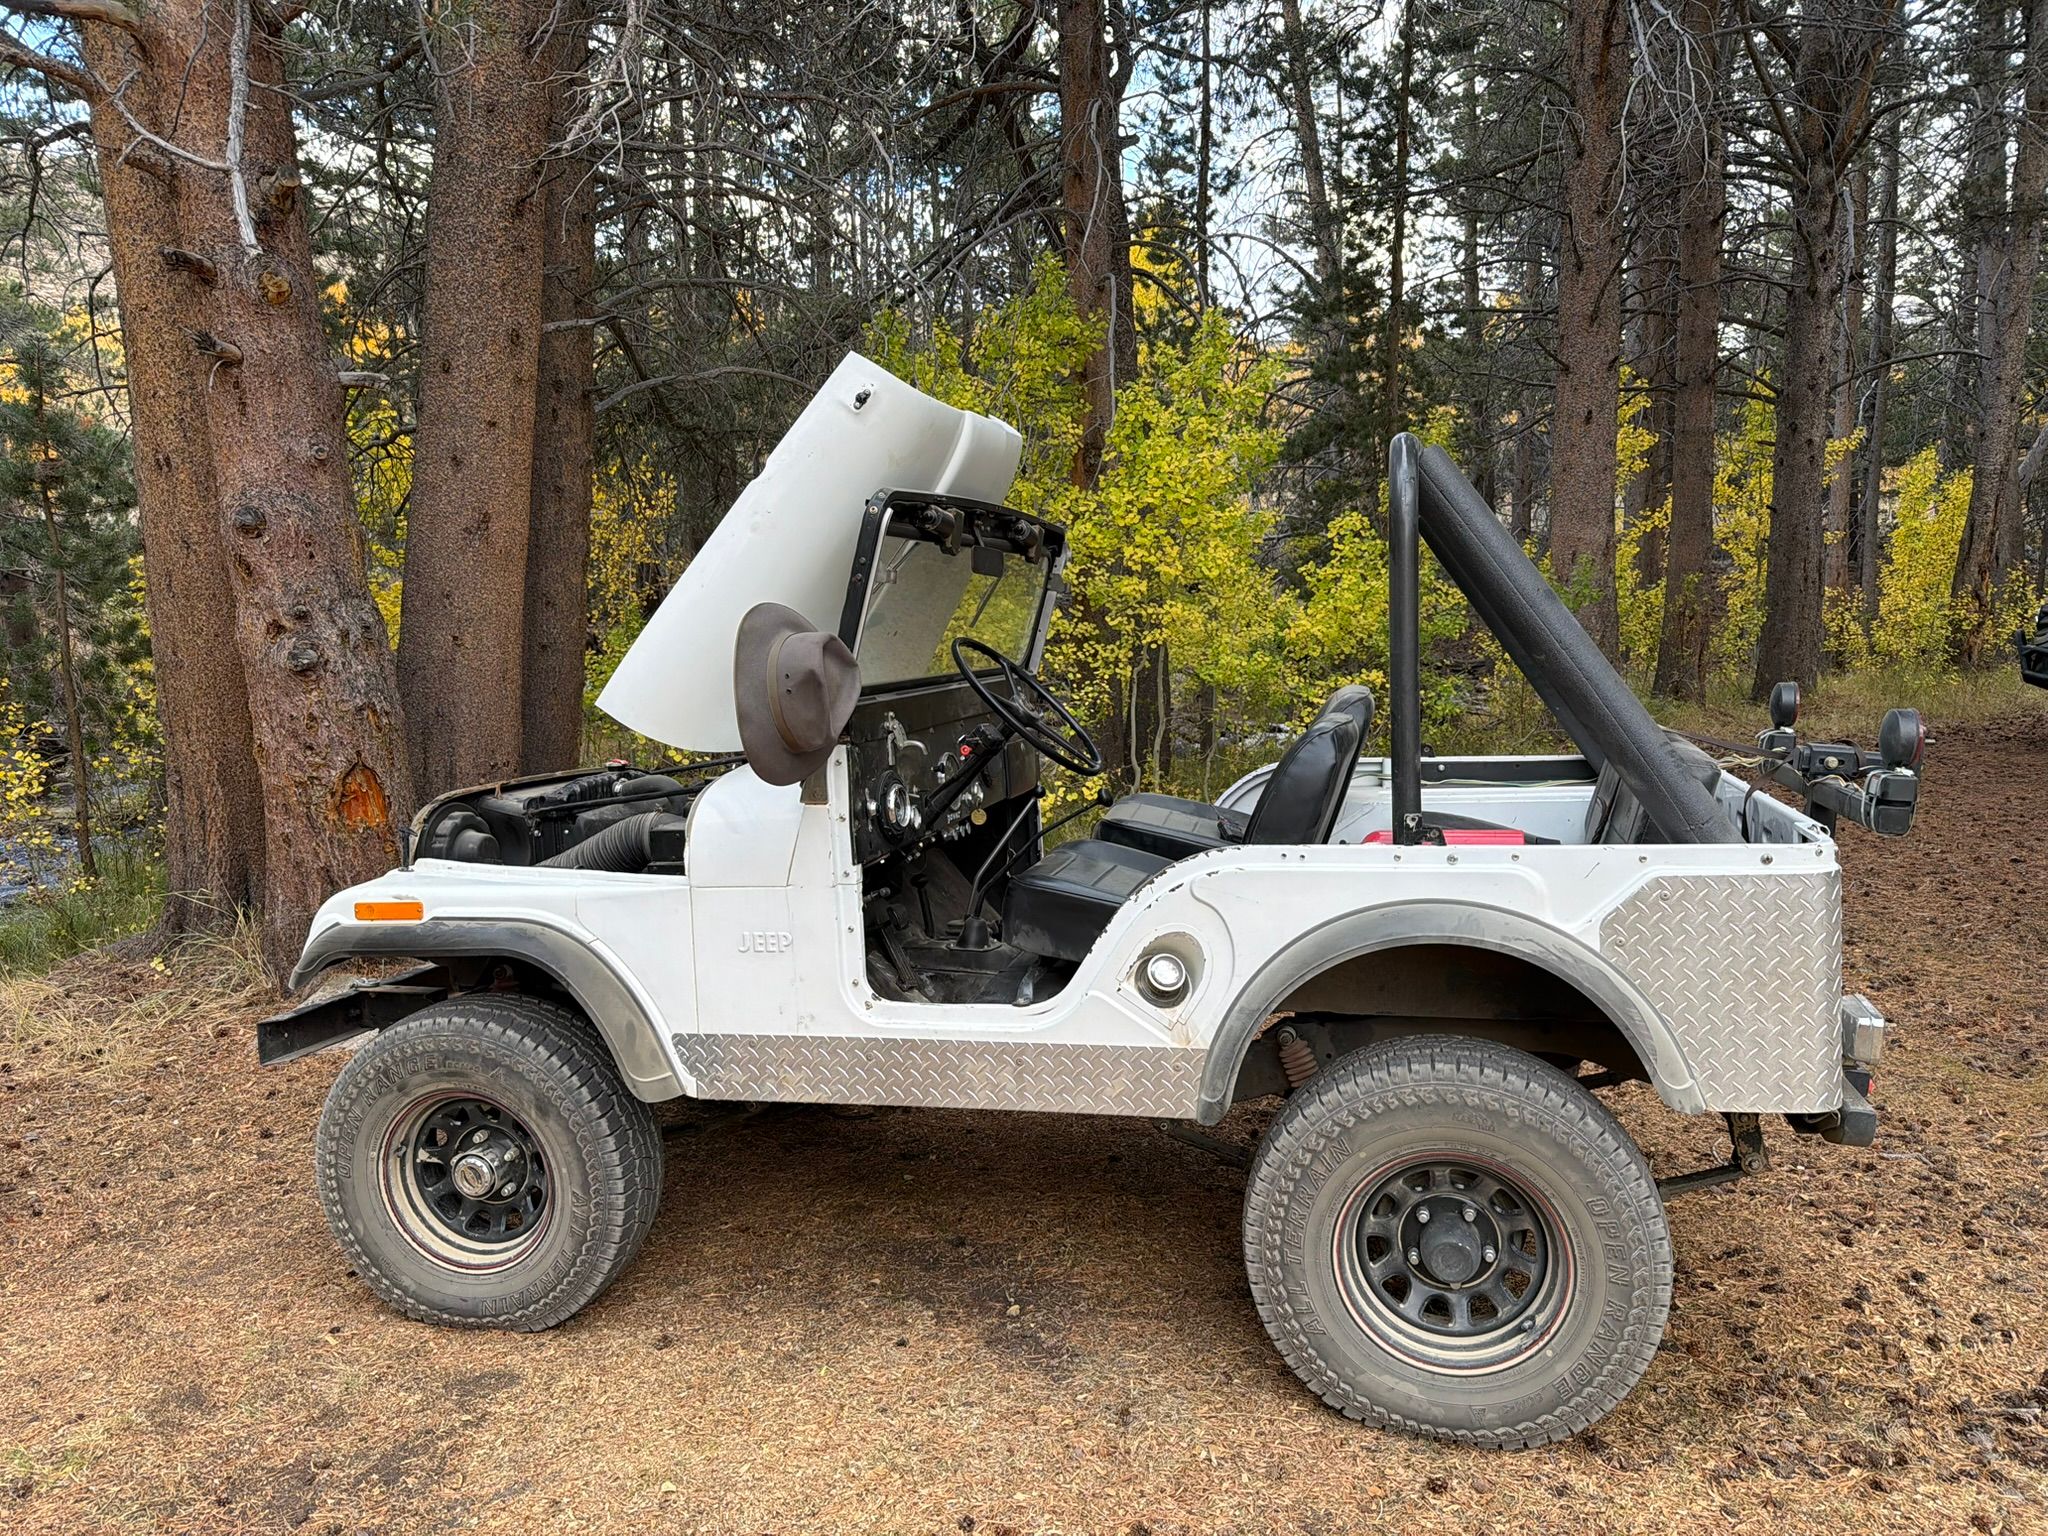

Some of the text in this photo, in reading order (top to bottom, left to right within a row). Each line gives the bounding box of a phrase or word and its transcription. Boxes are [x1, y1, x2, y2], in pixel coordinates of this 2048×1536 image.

[738, 931, 794, 954] JEEP
[337, 1053, 438, 1179] OPEN RANGE
[481, 1248, 577, 1315] TERRAIN
[1284, 1137, 1353, 1336] ALL TERRAIN
[1553, 1198, 1631, 1400] OPEN RANGE
